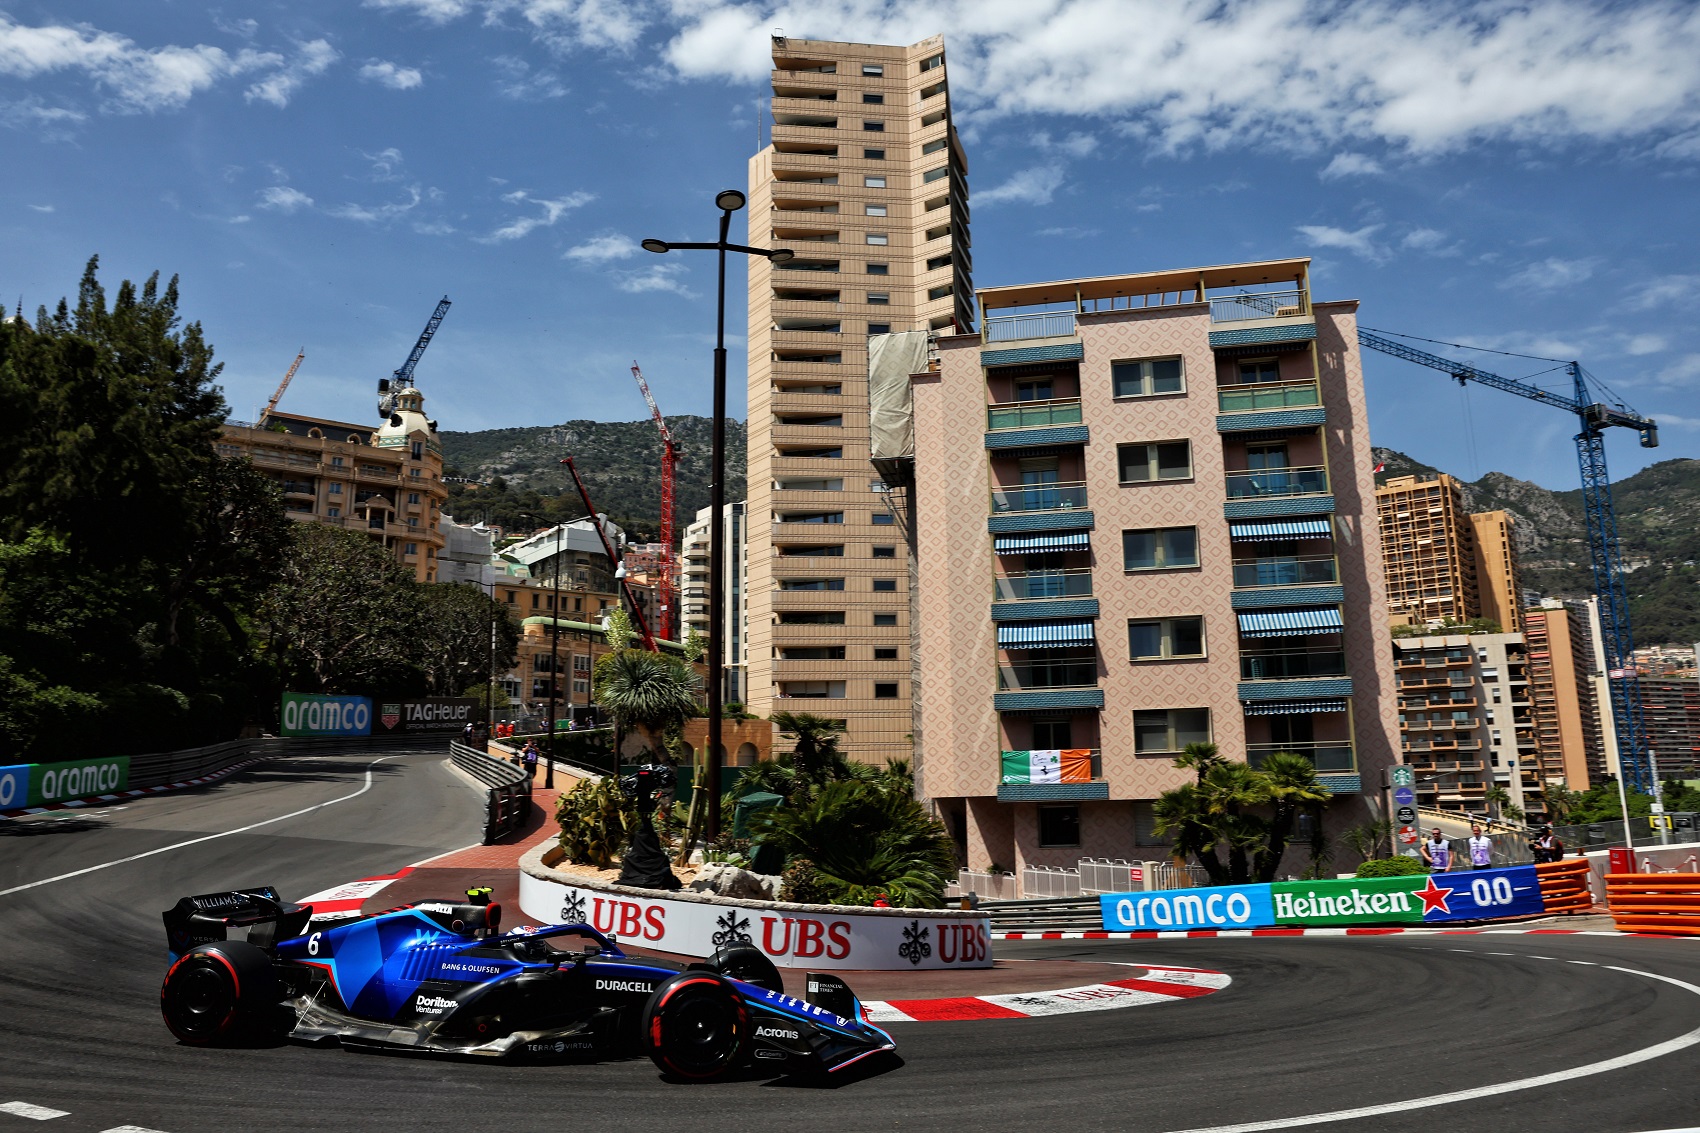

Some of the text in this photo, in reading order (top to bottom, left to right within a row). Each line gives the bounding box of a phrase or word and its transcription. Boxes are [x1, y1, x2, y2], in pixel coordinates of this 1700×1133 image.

[284, 700, 369, 730] aramco
[42, 764, 119, 799] aramco
[193, 895, 237, 909] WILLIAMS
[1116, 892, 1251, 927] aramco
[1274, 891, 1412, 919] Heineken
[592, 897, 666, 941] UBS
[308, 931, 322, 956] 6
[760, 916, 851, 960] UBS
[936, 923, 986, 963] UBS
[441, 962, 461, 971] BANG
[467, 964, 500, 974] OLUFSEN
[595, 979, 654, 993] DURACELL
[415, 1005, 443, 1014] Ventures
[416, 995, 459, 1008] Dorilton
[755, 1025, 799, 1040] Acronis
[527, 1042, 593, 1052] TERRA VIRTUA
